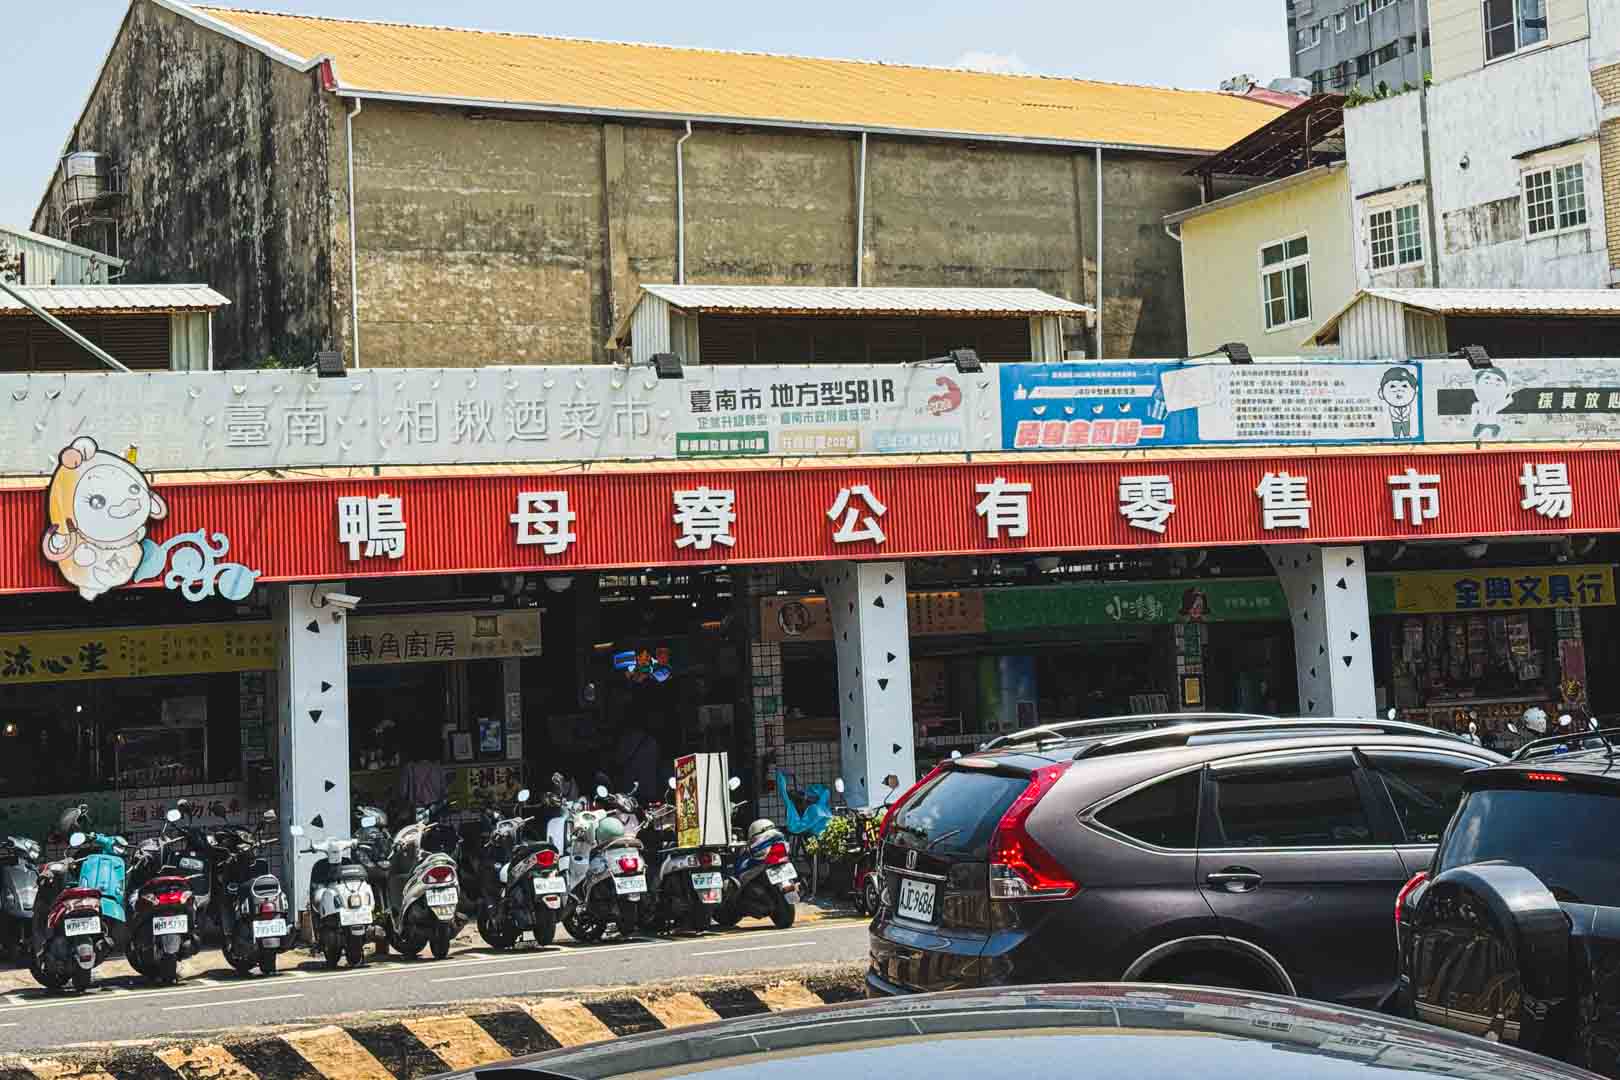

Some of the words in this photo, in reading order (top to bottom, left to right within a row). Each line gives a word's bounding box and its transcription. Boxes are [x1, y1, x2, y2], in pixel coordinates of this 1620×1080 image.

[338, 461, 1573, 562] 鴨母寮公有零售市場
